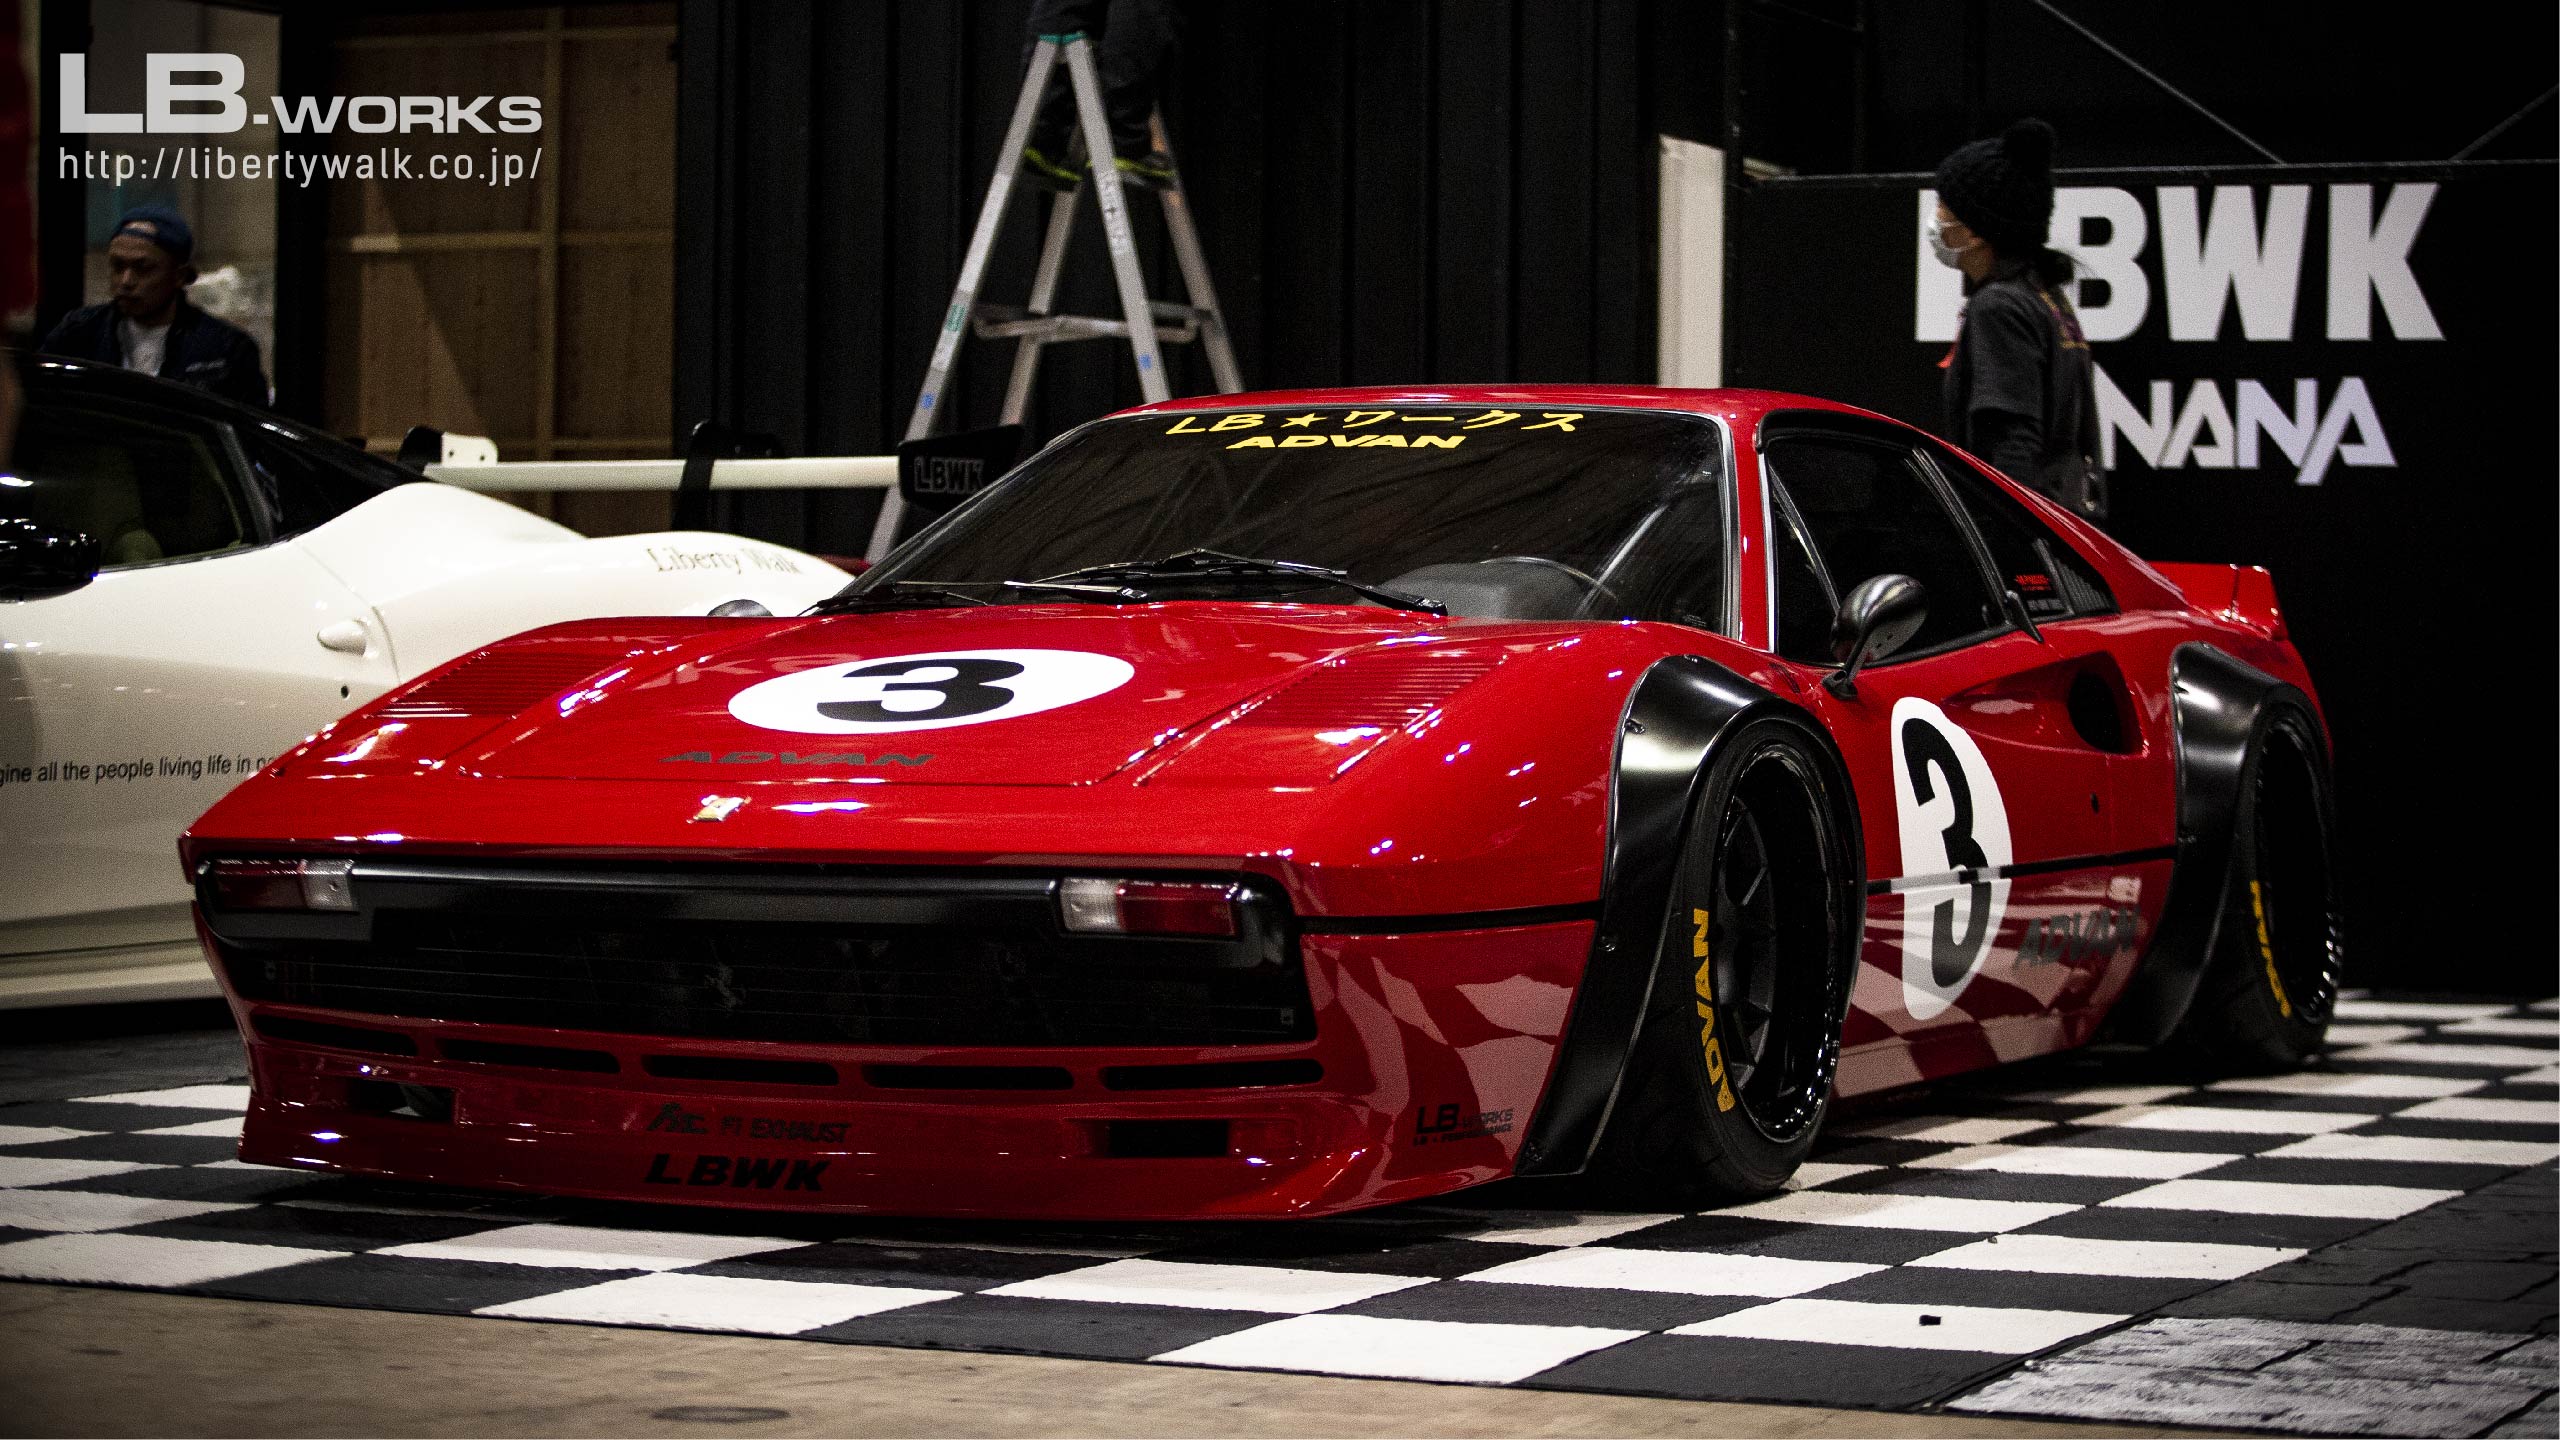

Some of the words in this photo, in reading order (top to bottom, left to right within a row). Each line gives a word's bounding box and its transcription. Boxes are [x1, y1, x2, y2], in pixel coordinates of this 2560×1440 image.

[1226, 434, 1466, 450] ADVAN
[646, 546, 742, 575] Liberty
[817, 658, 1025, 722] 3
[38, 761, 58, 782] all
[63, 761, 90, 781] the
[95, 758, 153, 785] people
[159, 756, 202, 780] living
[207, 754, 231, 775] life
[236, 753, 251, 774] in
[659, 751, 935, 767] ADVAN
[1901, 718, 1992, 989] 3
[2012, 905, 2142, 969] ADVAN
[1693, 908, 1737, 1112] ADVAN
[751, 1118, 852, 1144] EXHAUST
[643, 1153, 832, 1191] LBWK
